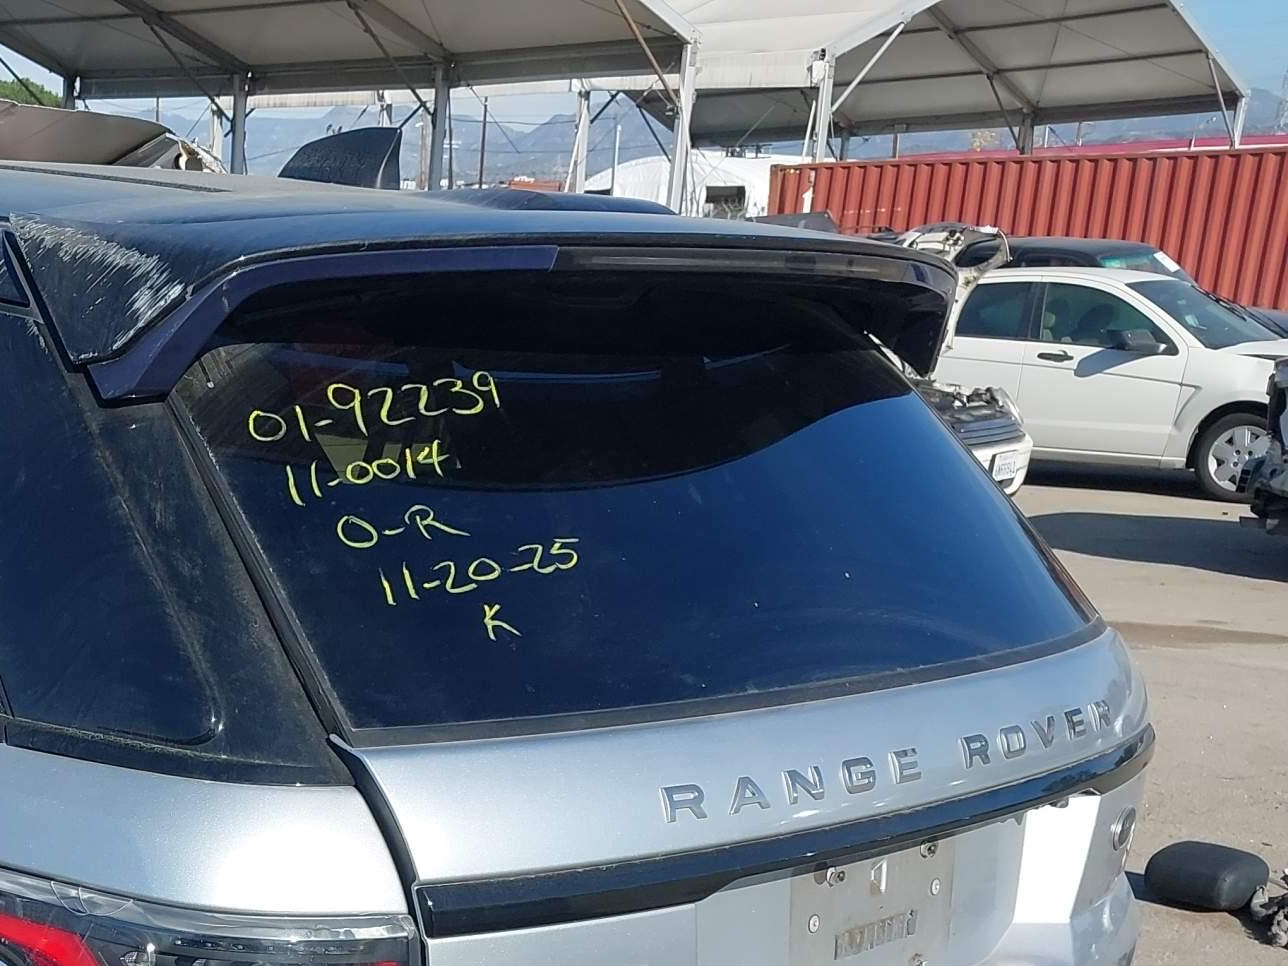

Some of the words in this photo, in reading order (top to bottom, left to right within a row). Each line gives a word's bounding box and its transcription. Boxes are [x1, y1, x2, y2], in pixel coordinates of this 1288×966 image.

[286, 439, 450, 507] 11-0014
[483, 603, 522, 641] K
[659, 747, 923, 824] RANGE
[959, 699, 1112, 770] ROVER
